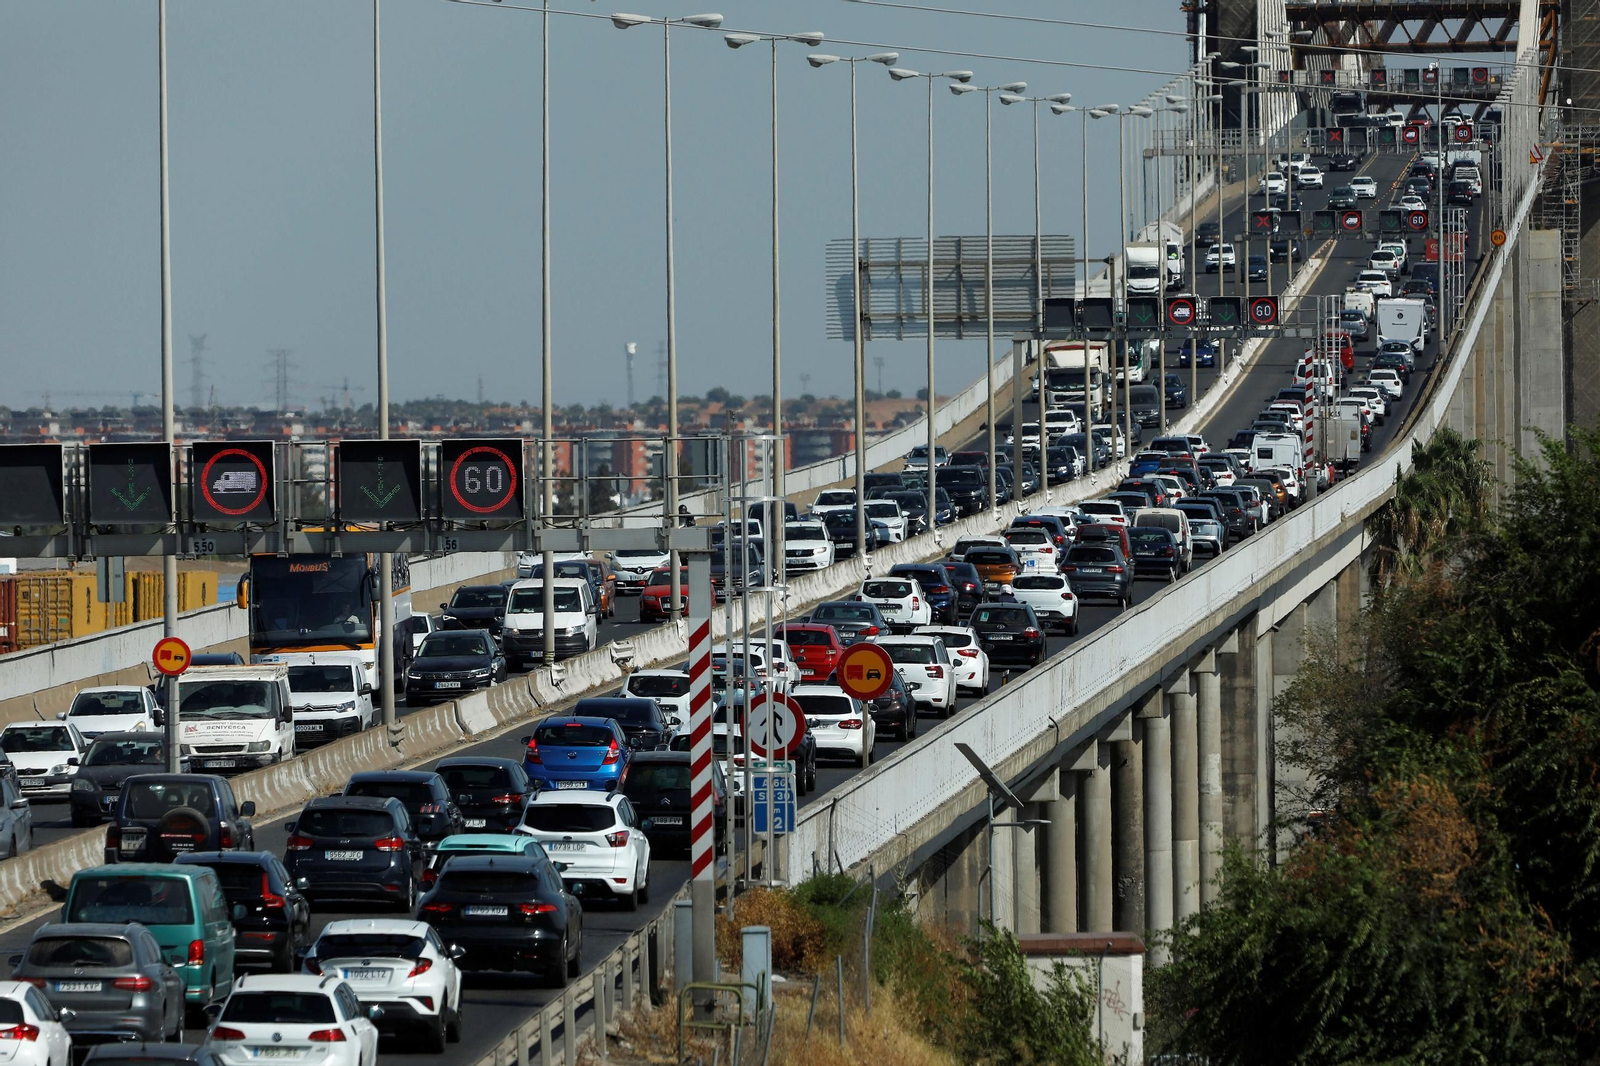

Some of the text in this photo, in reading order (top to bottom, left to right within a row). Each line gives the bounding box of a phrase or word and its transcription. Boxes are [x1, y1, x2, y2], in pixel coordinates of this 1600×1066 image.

[1413, 215, 1424, 224] 60
[1256, 305, 1271, 316] 60
[464, 466, 502, 493] 60
[762, 779, 787, 787] A66
[758, 792, 790, 800] S-30
[350, 970, 386, 978] 1002 LTZ
